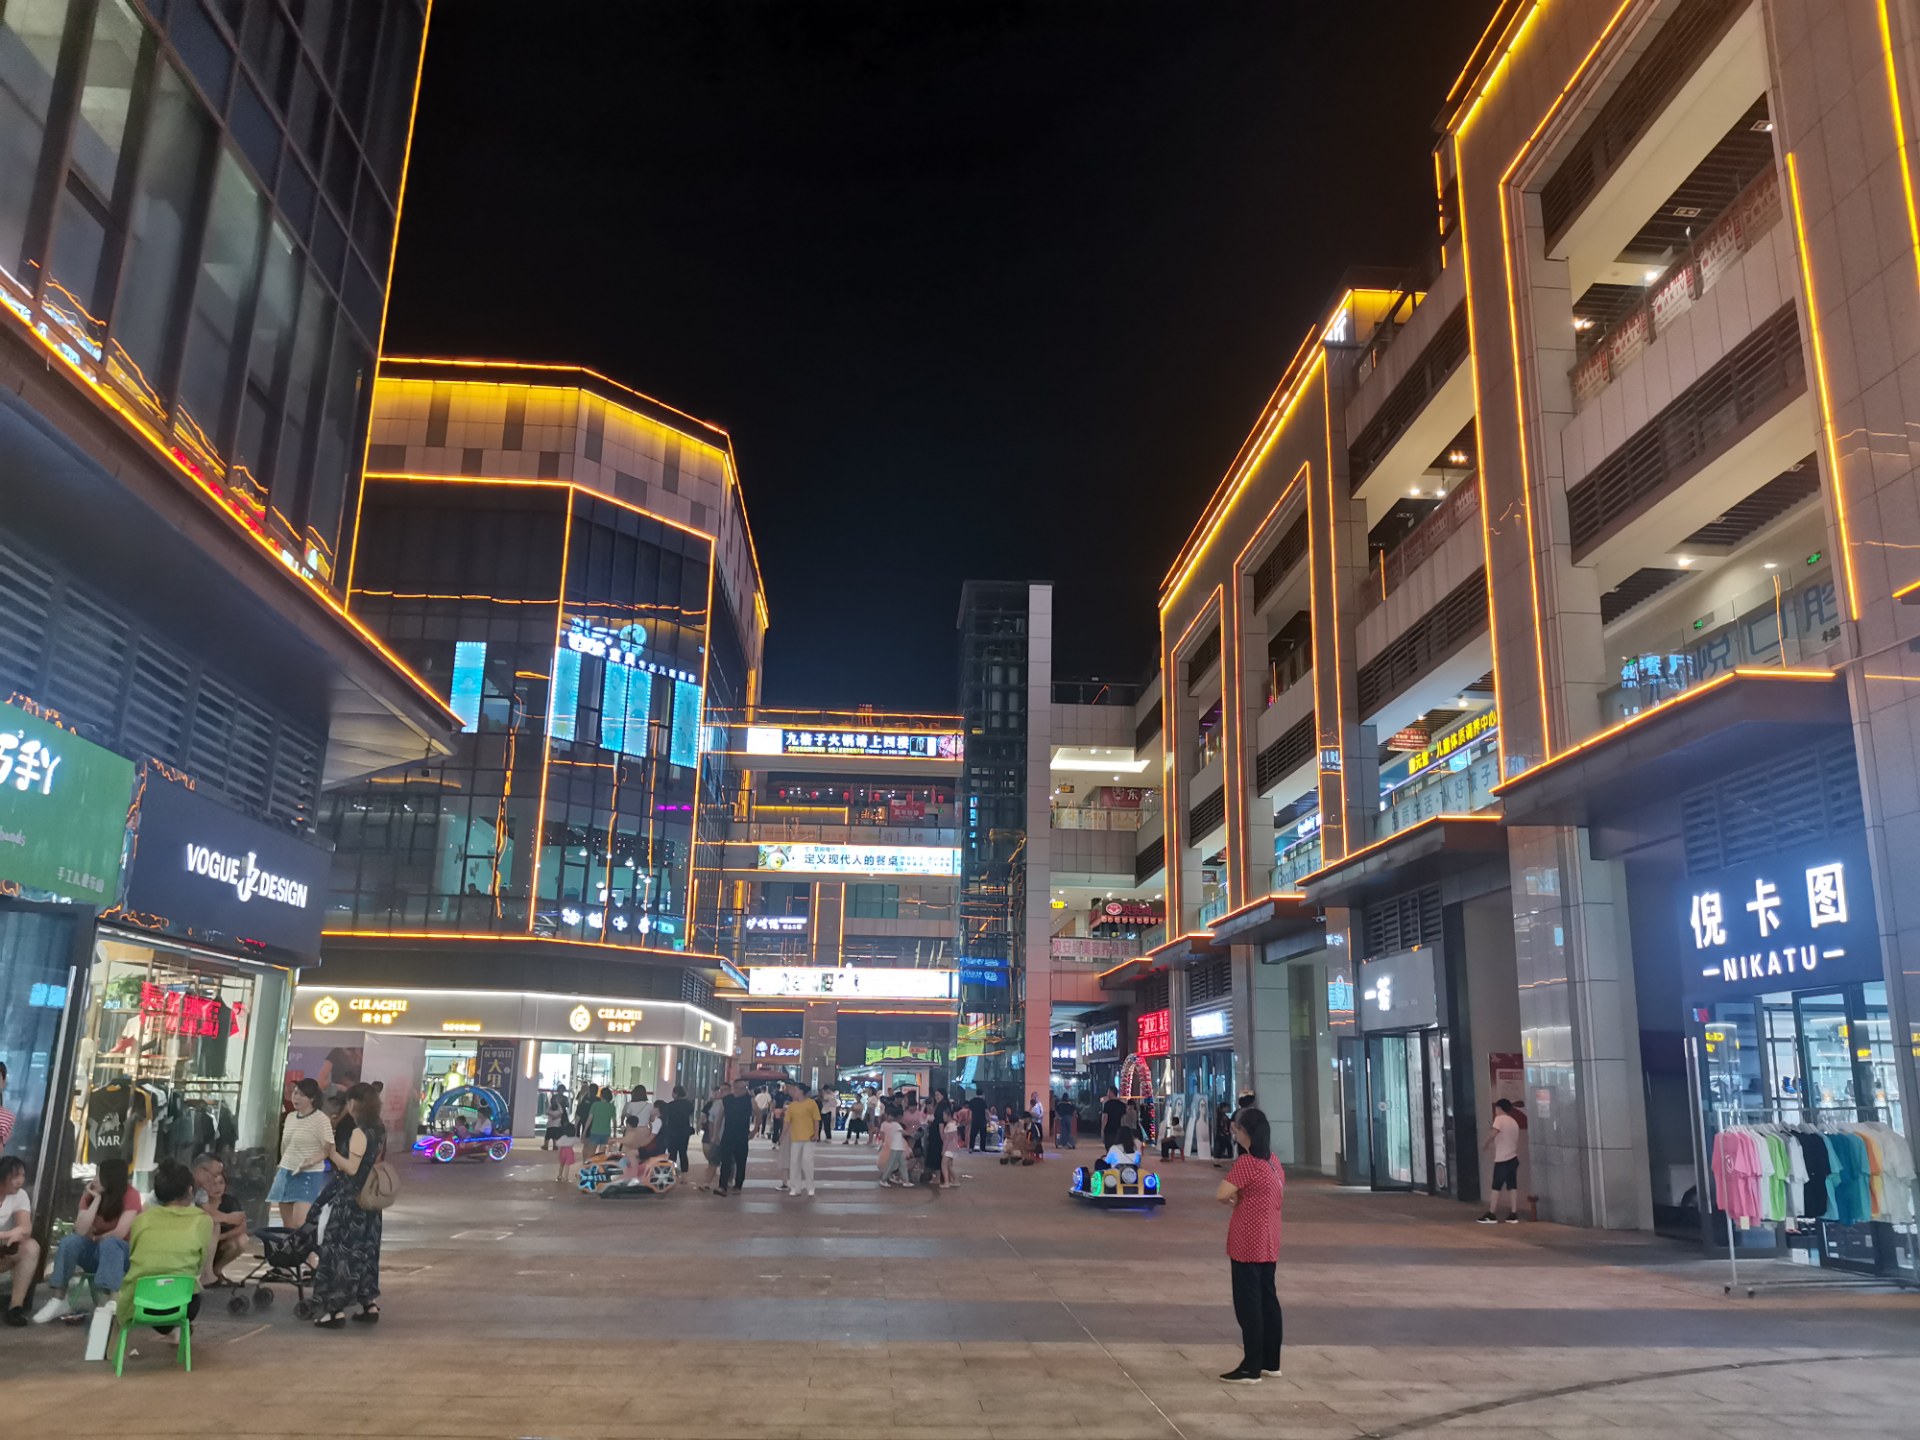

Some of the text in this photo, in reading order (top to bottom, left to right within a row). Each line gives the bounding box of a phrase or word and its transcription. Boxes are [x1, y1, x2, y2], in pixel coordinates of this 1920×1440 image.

[187, 843, 240, 885] VOGUE
[258, 872, 308, 908] DESIGN
[804, 852, 899, 867] 定义现代人的餐桌
[1690, 862, 1848, 949] 倪卡图
[97, 1135, 121, 1147] NAR
